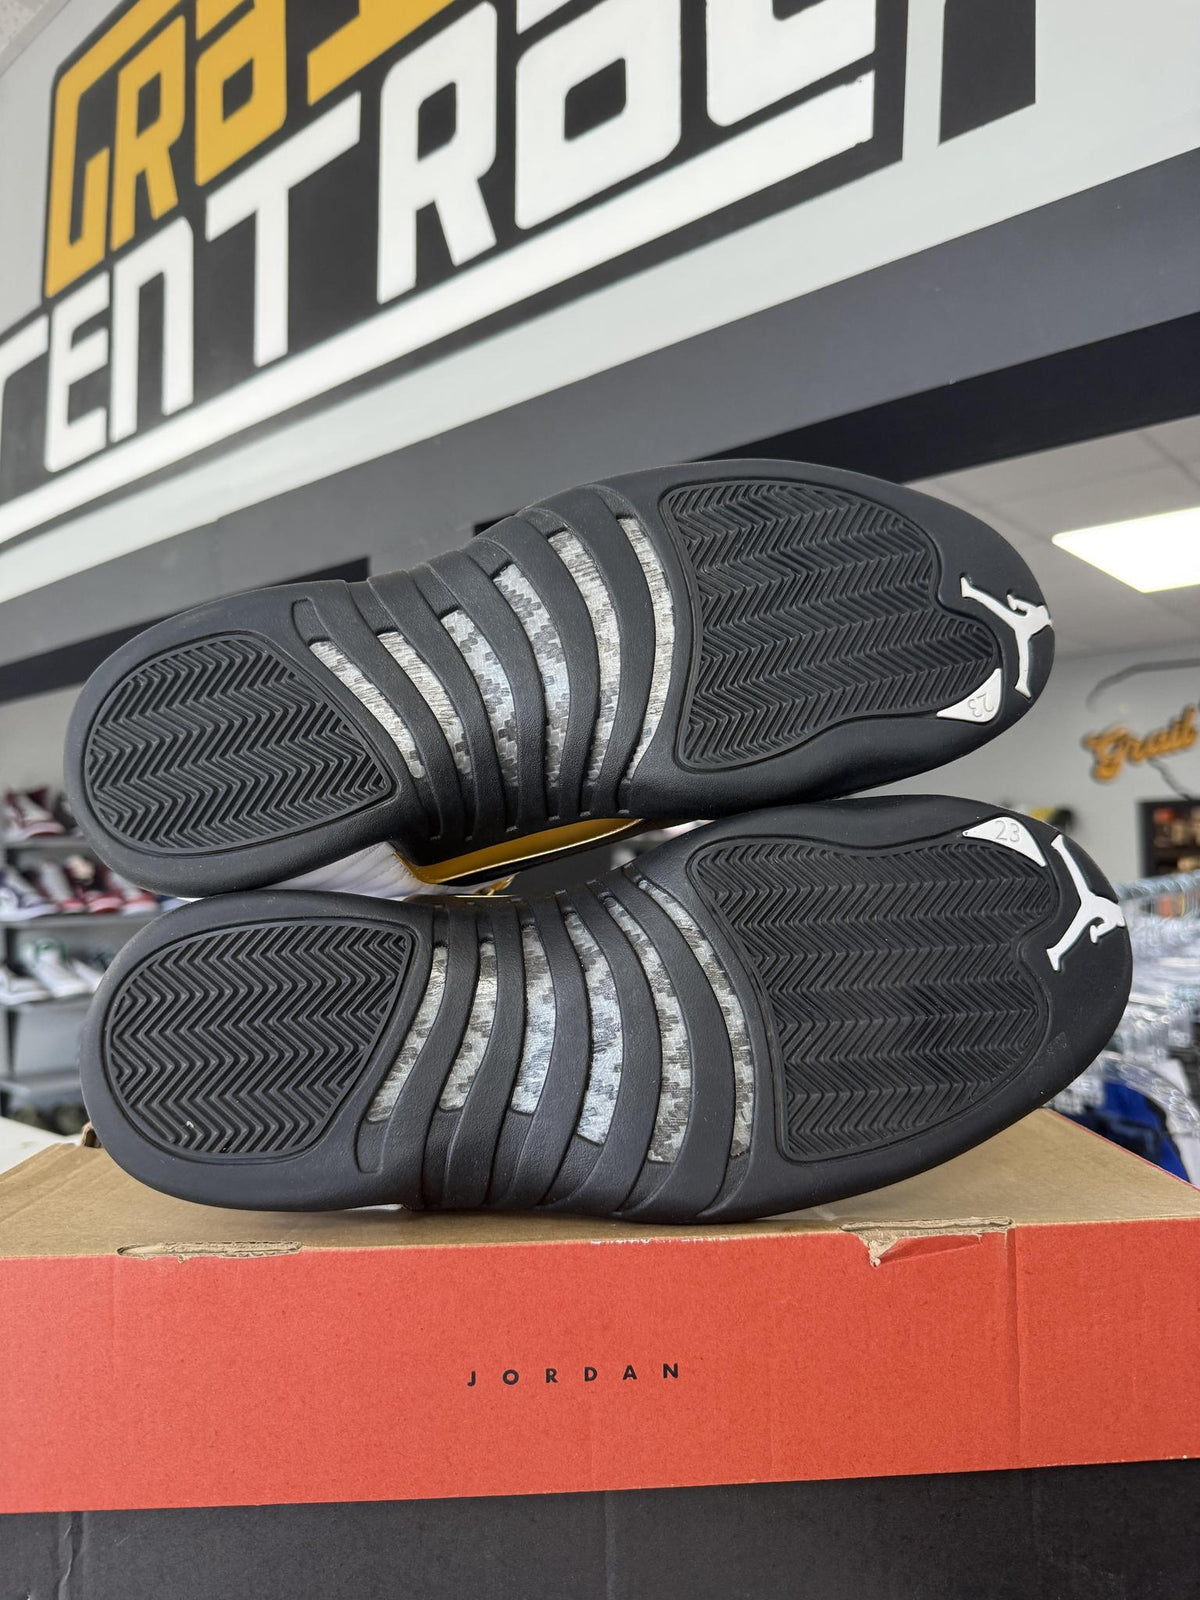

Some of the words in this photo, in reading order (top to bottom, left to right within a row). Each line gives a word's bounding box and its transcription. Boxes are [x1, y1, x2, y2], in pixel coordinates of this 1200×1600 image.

[967, 692, 995, 718] 23
[995, 819, 1021, 843] 23
[467, 1362, 679, 1387] JORDAN
